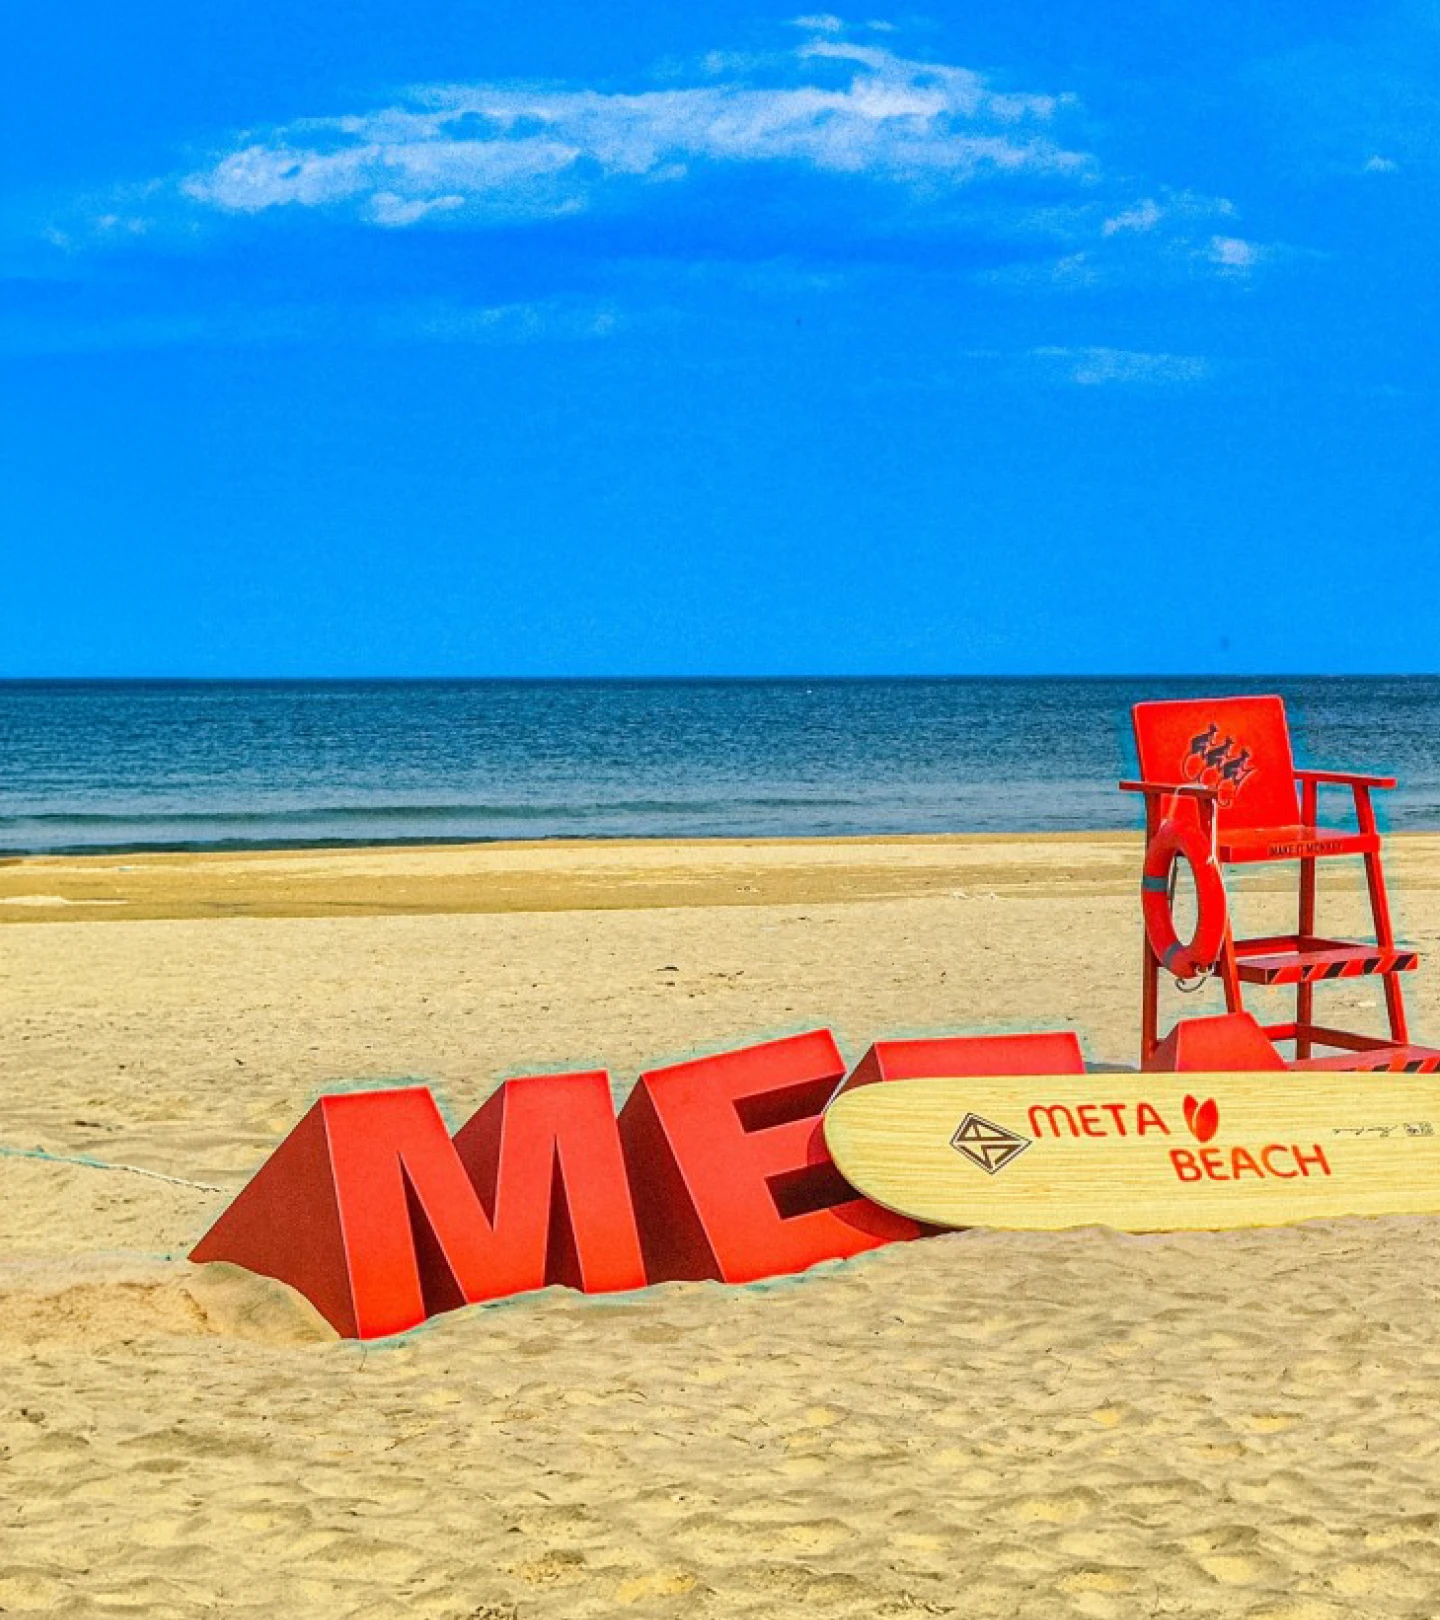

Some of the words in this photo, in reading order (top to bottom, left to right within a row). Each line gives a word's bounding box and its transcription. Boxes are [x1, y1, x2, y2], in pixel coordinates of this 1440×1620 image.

[1027, 1102, 1171, 1138] META
[318, 1010, 1290, 1341] ME
[1168, 1143, 1332, 1182] BEACH
